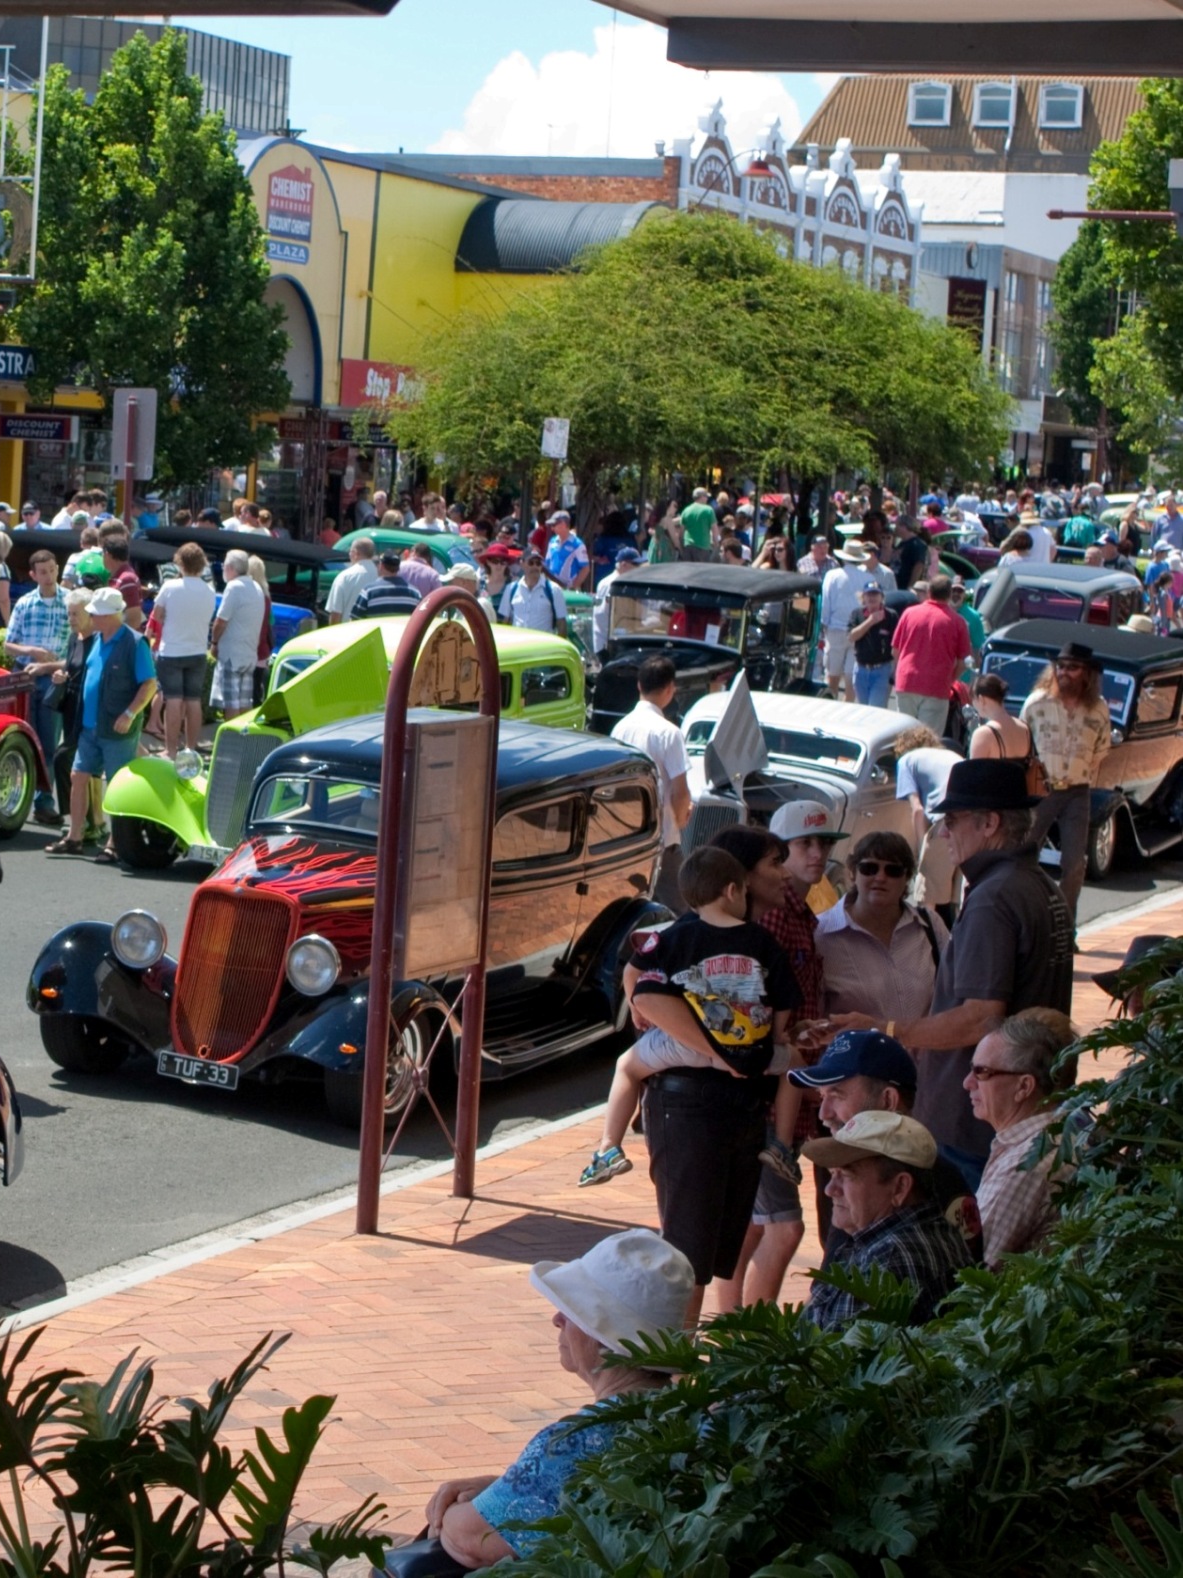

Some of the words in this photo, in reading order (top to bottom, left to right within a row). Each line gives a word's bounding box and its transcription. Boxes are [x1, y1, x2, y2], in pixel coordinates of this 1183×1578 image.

[270, 176, 312, 203] CHEMIST
[269, 242, 306, 259] PLAZA
[6, 419, 62, 429] DISCOUNT
[10, 429, 57, 438] CHEMIST
